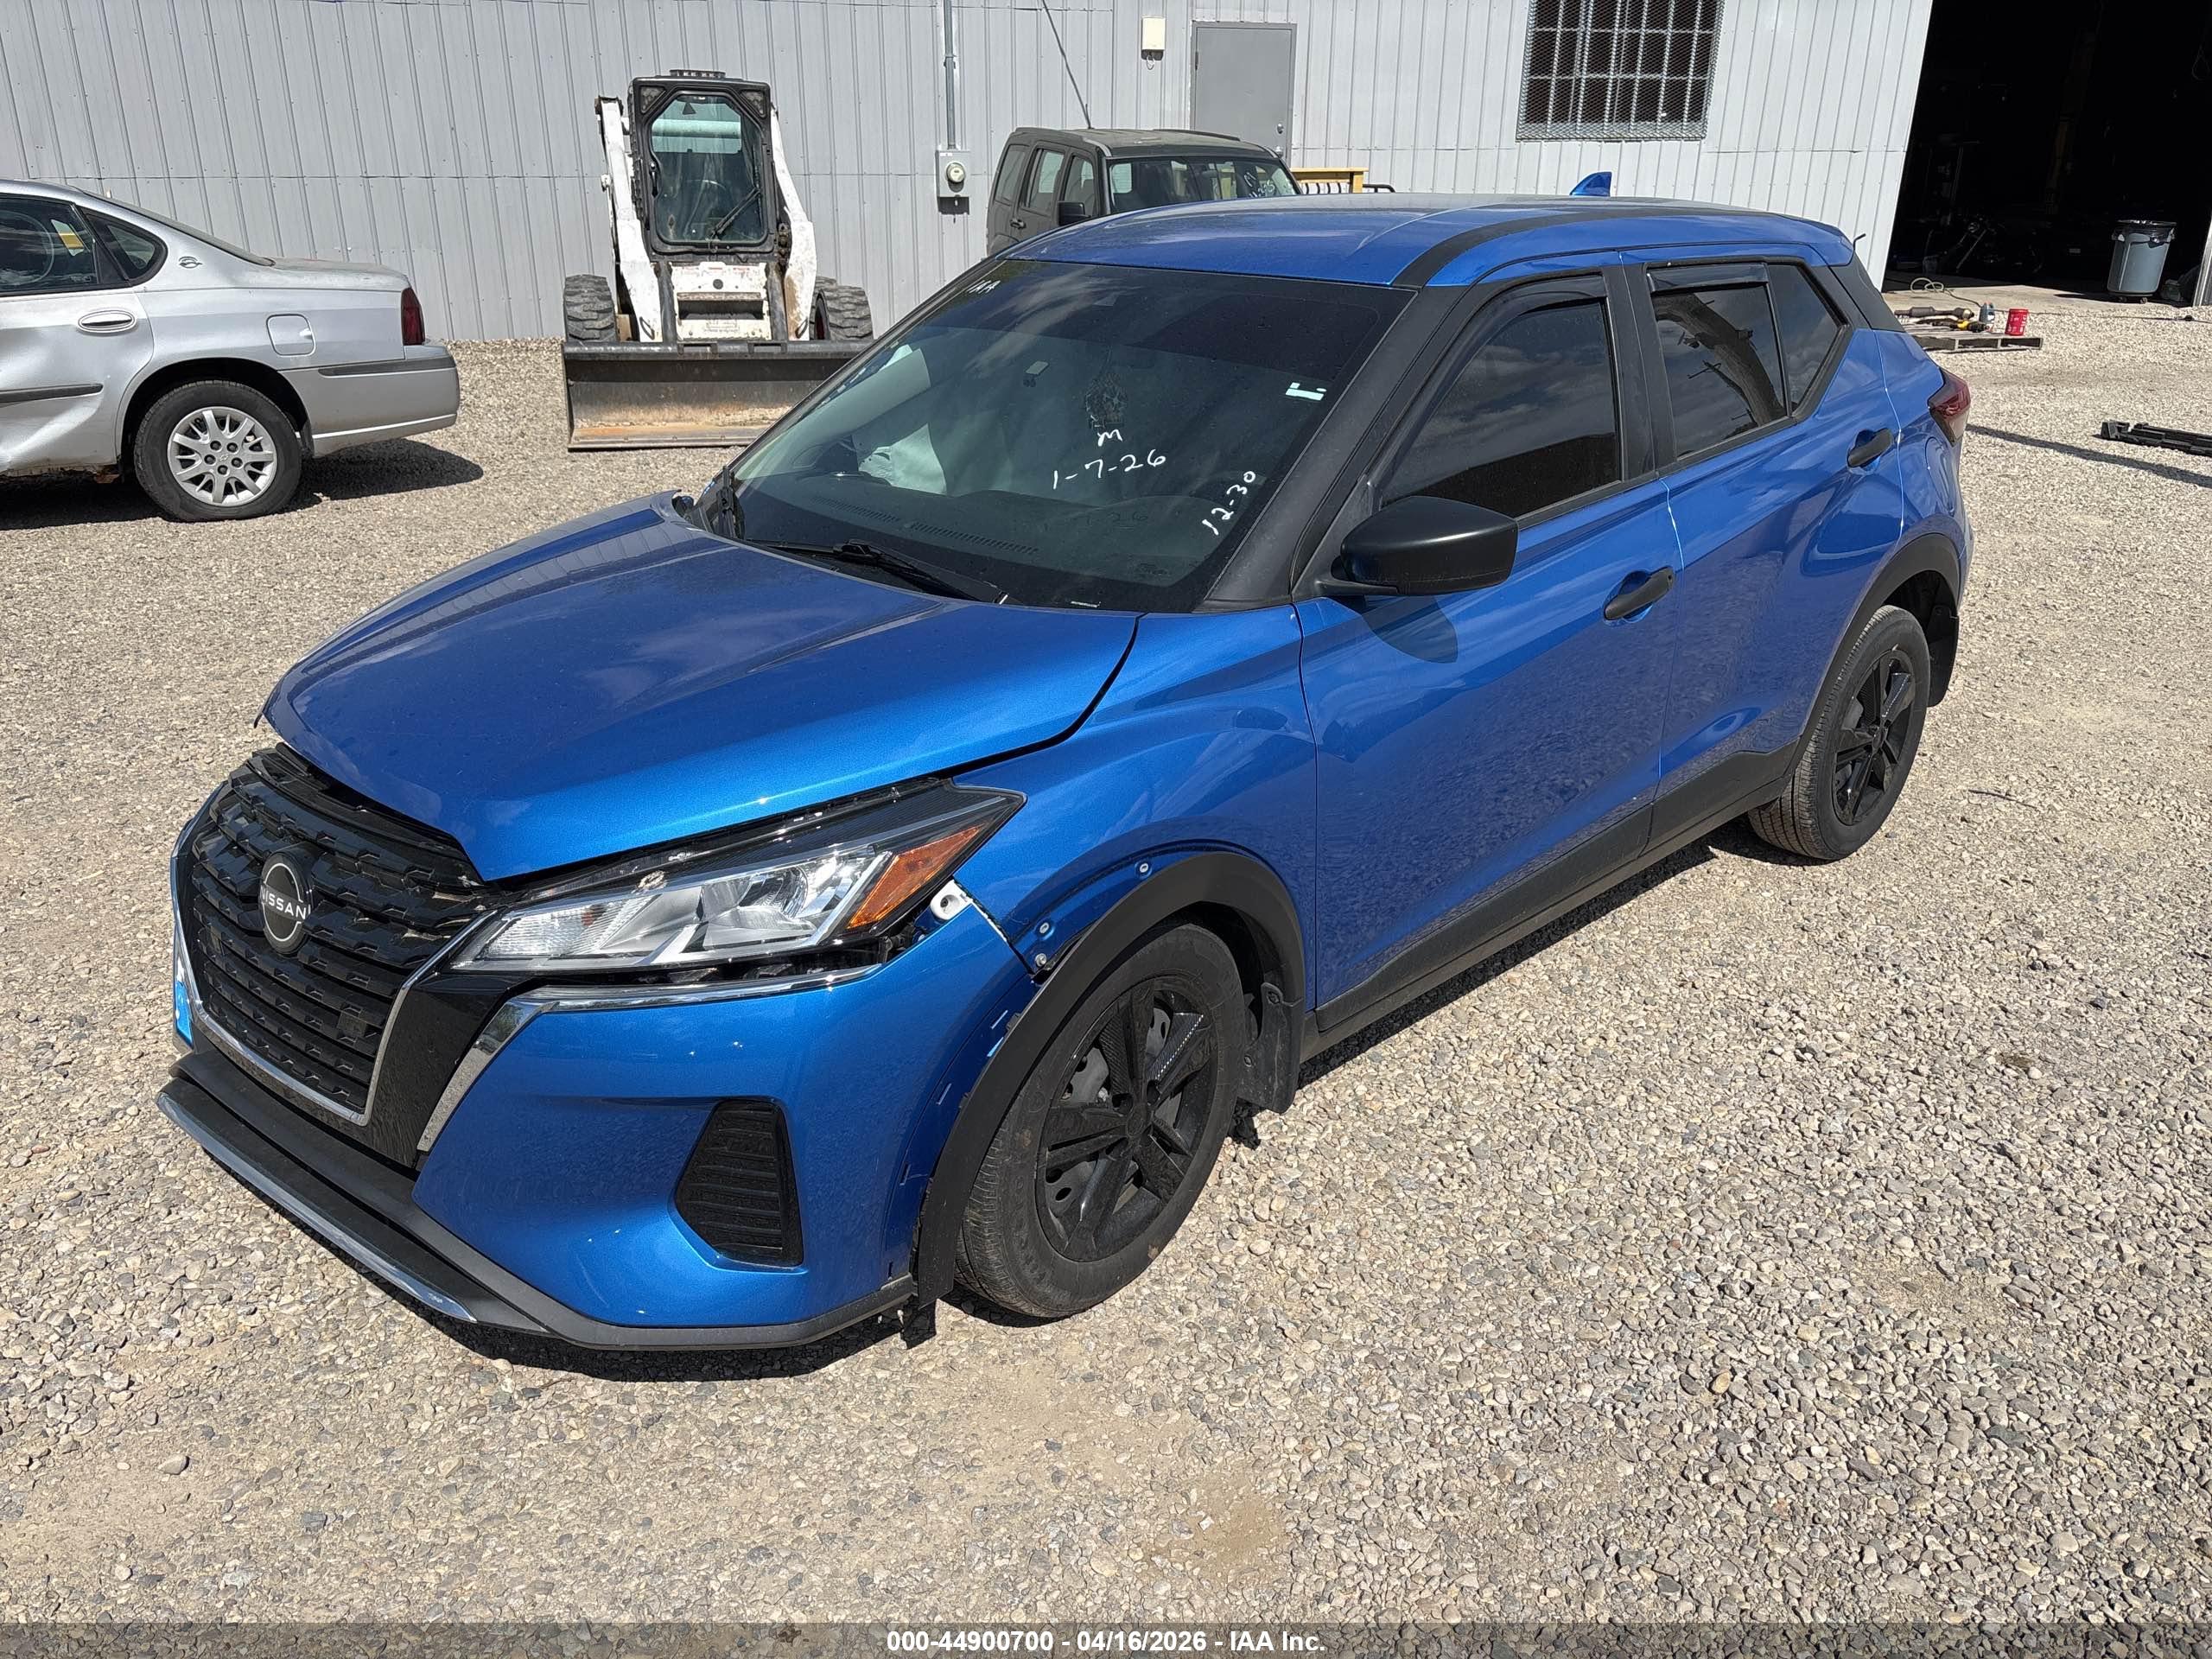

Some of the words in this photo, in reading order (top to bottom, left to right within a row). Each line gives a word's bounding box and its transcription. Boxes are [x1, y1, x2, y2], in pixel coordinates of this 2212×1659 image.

[1052, 448, 1166, 490] 1-7-26
[1202, 471, 1256, 536] 12-30
[260, 884, 307, 920] NISSAN
